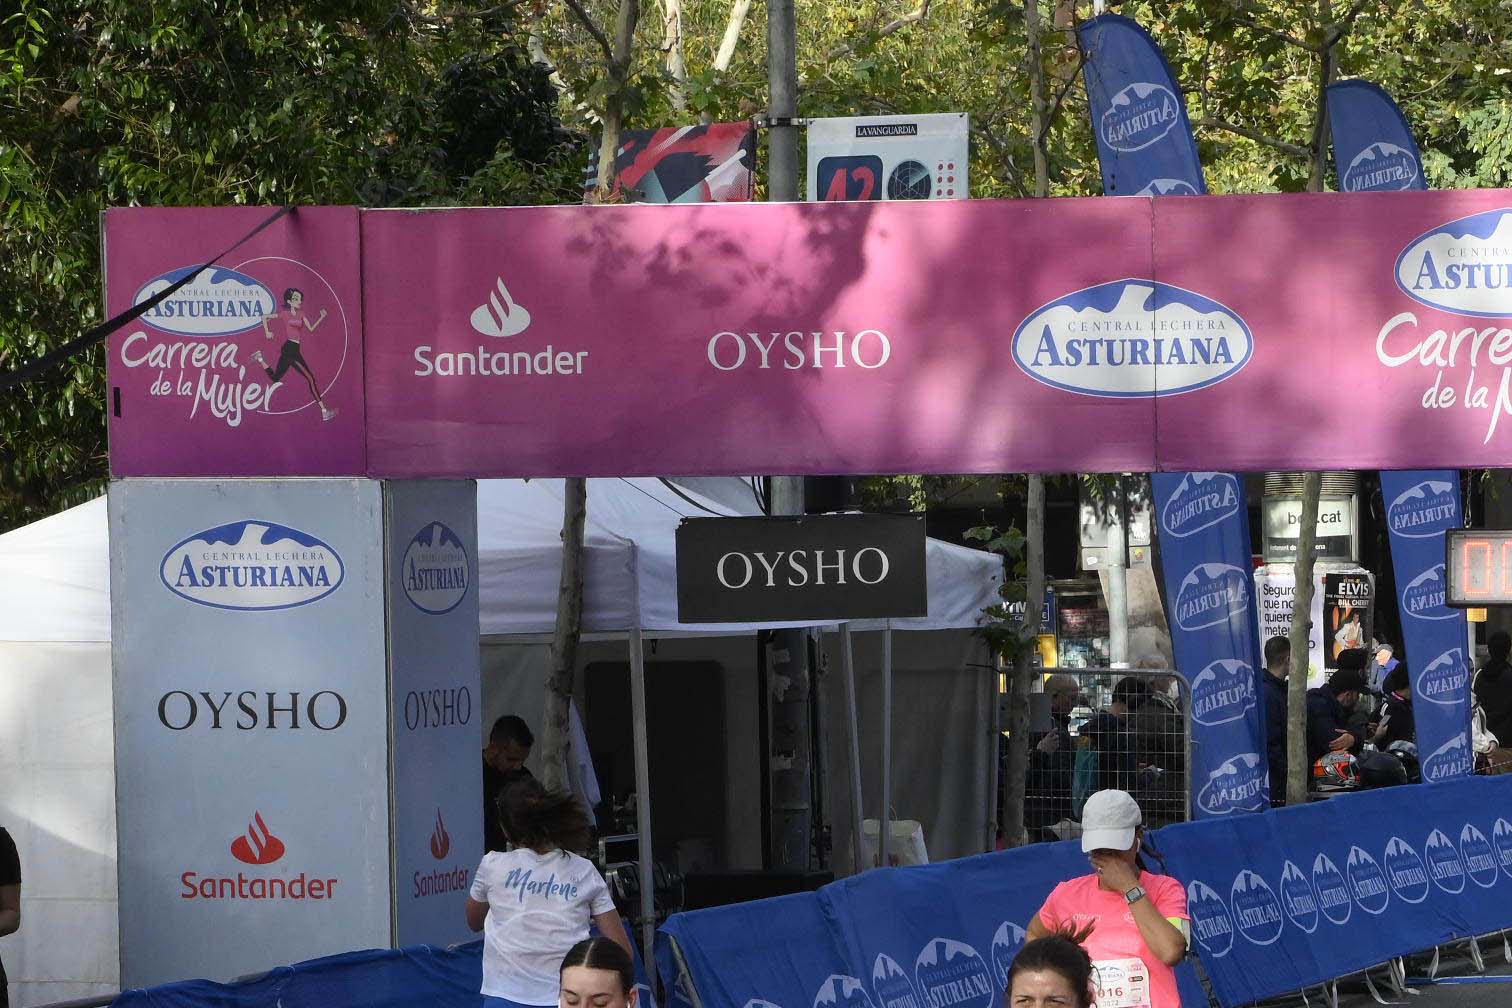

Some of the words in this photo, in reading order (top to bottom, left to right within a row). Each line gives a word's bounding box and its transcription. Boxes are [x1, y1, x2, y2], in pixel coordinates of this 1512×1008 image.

[144, 290, 264, 318] ASTURIANA
[172, 288, 211, 298] ENTRAL
[1067, 320, 1144, 333] CENTRAL
[1151, 319, 1227, 332] LECHERA
[121, 331, 240, 369] Carrera
[414, 345, 589, 378] Santander
[706, 329, 892, 371] OYSHO
[1030, 323, 1235, 368] ASTURIANA
[150, 370, 173, 396] de
[177, 370, 193, 396] la
[189, 365, 284, 427] Mujer
[1421, 369, 1457, 410] de
[1463, 369, 1489, 409] la
[175, 553, 332, 589] ASTURIANA
[202, 551, 262, 562] CENTRAL
[266, 550, 325, 562] LECHERA
[716, 546, 891, 590] OYSHO
[408, 556, 465, 593] ASTURIANA
[1338, 582, 1369, 596] ELVIS
[1263, 600, 1281, 612] que
[1264, 610, 1293, 626] quiere
[158, 690, 348, 731] OYSHO
[404, 685, 472, 732] OYSHO
[181, 871, 338, 901] Santander
[414, 866, 470, 900] Santander
[1097, 986, 1124, 999] 016
